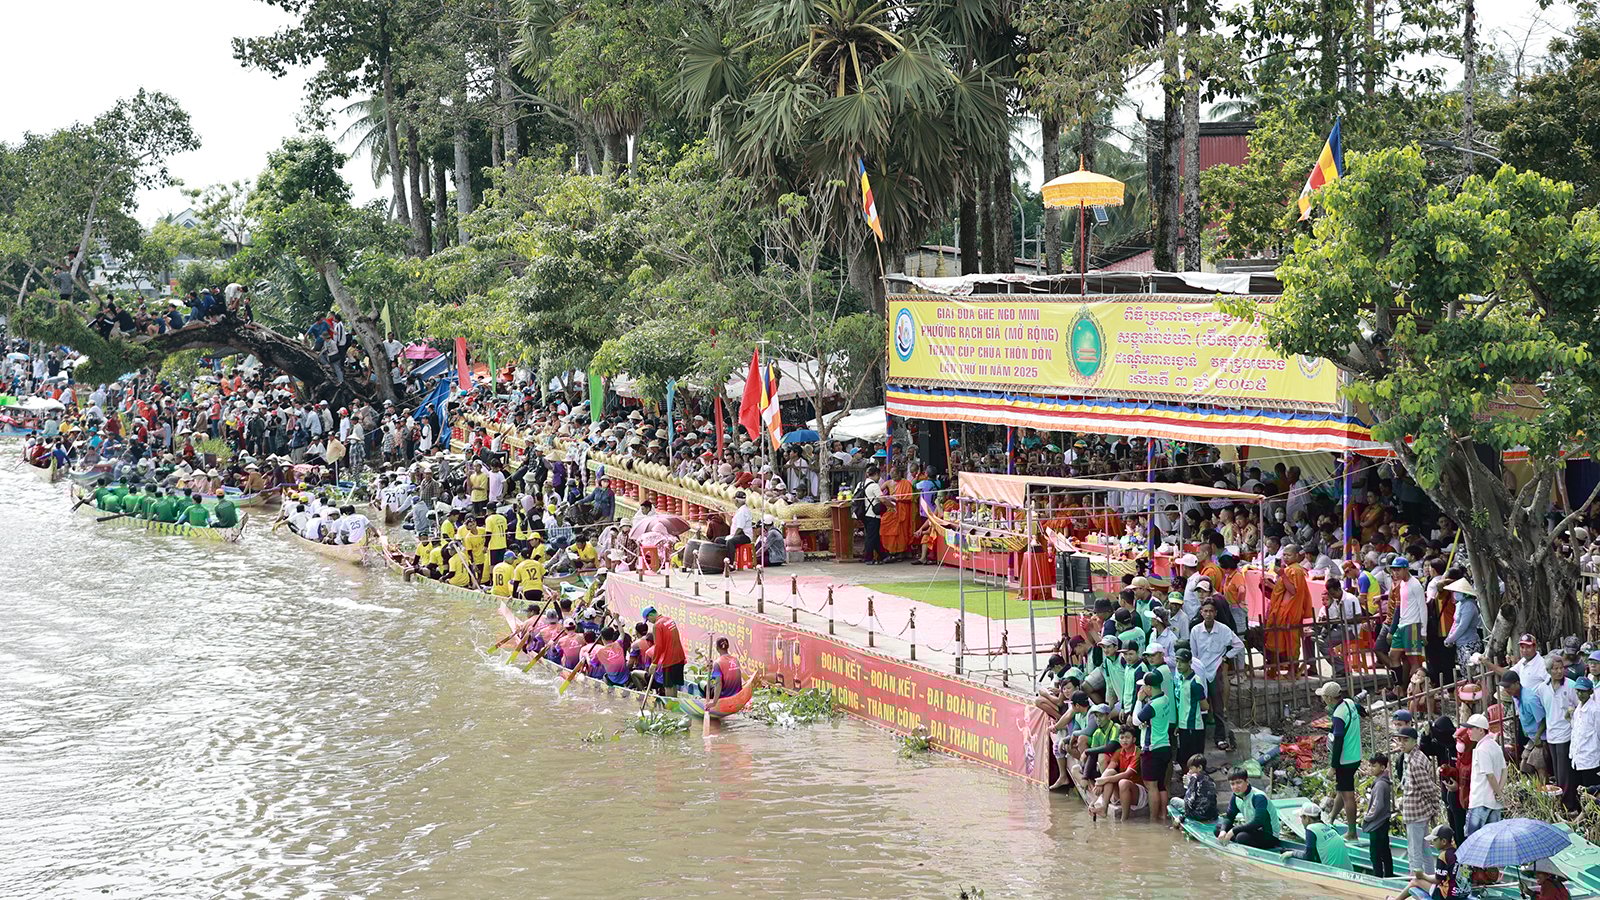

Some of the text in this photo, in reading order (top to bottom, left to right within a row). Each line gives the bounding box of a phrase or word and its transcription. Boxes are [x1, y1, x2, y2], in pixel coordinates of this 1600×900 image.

[958, 308, 975, 320] ĐUA
[978, 308, 994, 320] GHE
[997, 308, 1015, 320] NGO
[1018, 308, 1040, 320] MINI
[921, 323, 1059, 343] PHƯỜNG RẠCH GIÁ (MỞ RỘNG)
[928, 344, 1052, 361] TRANH CÚP CHÙA THÔN DÔN
[939, 361, 1038, 378] LẦN THỨ III NĂM 2025
[1214, 377, 1267, 391] ២០២៥
[385, 492, 396, 504] 23
[350, 520, 361, 531] 25
[495, 573, 504, 586] 18
[526, 567, 538, 581] 12
[821, 652, 844, 676] ĐOÀN
[845, 658, 861, 681] KẾT
[870, 669, 896, 694] ĐOÀN
[898, 675, 917, 700] KẾT
[927, 687, 944, 712] ĐẠI
[946, 693, 975, 720] ĐOÀN
[976, 701, 999, 728] KẾT.
[838, 685, 859, 710] CÔNG
[867, 697, 895, 724] THÀNH
[897, 706, 921, 730] CÔNG
[930, 719, 947, 744] ĐẠI
[949, 725, 980, 754] THÀNH
[982, 736, 1012, 766] CÔNG.
